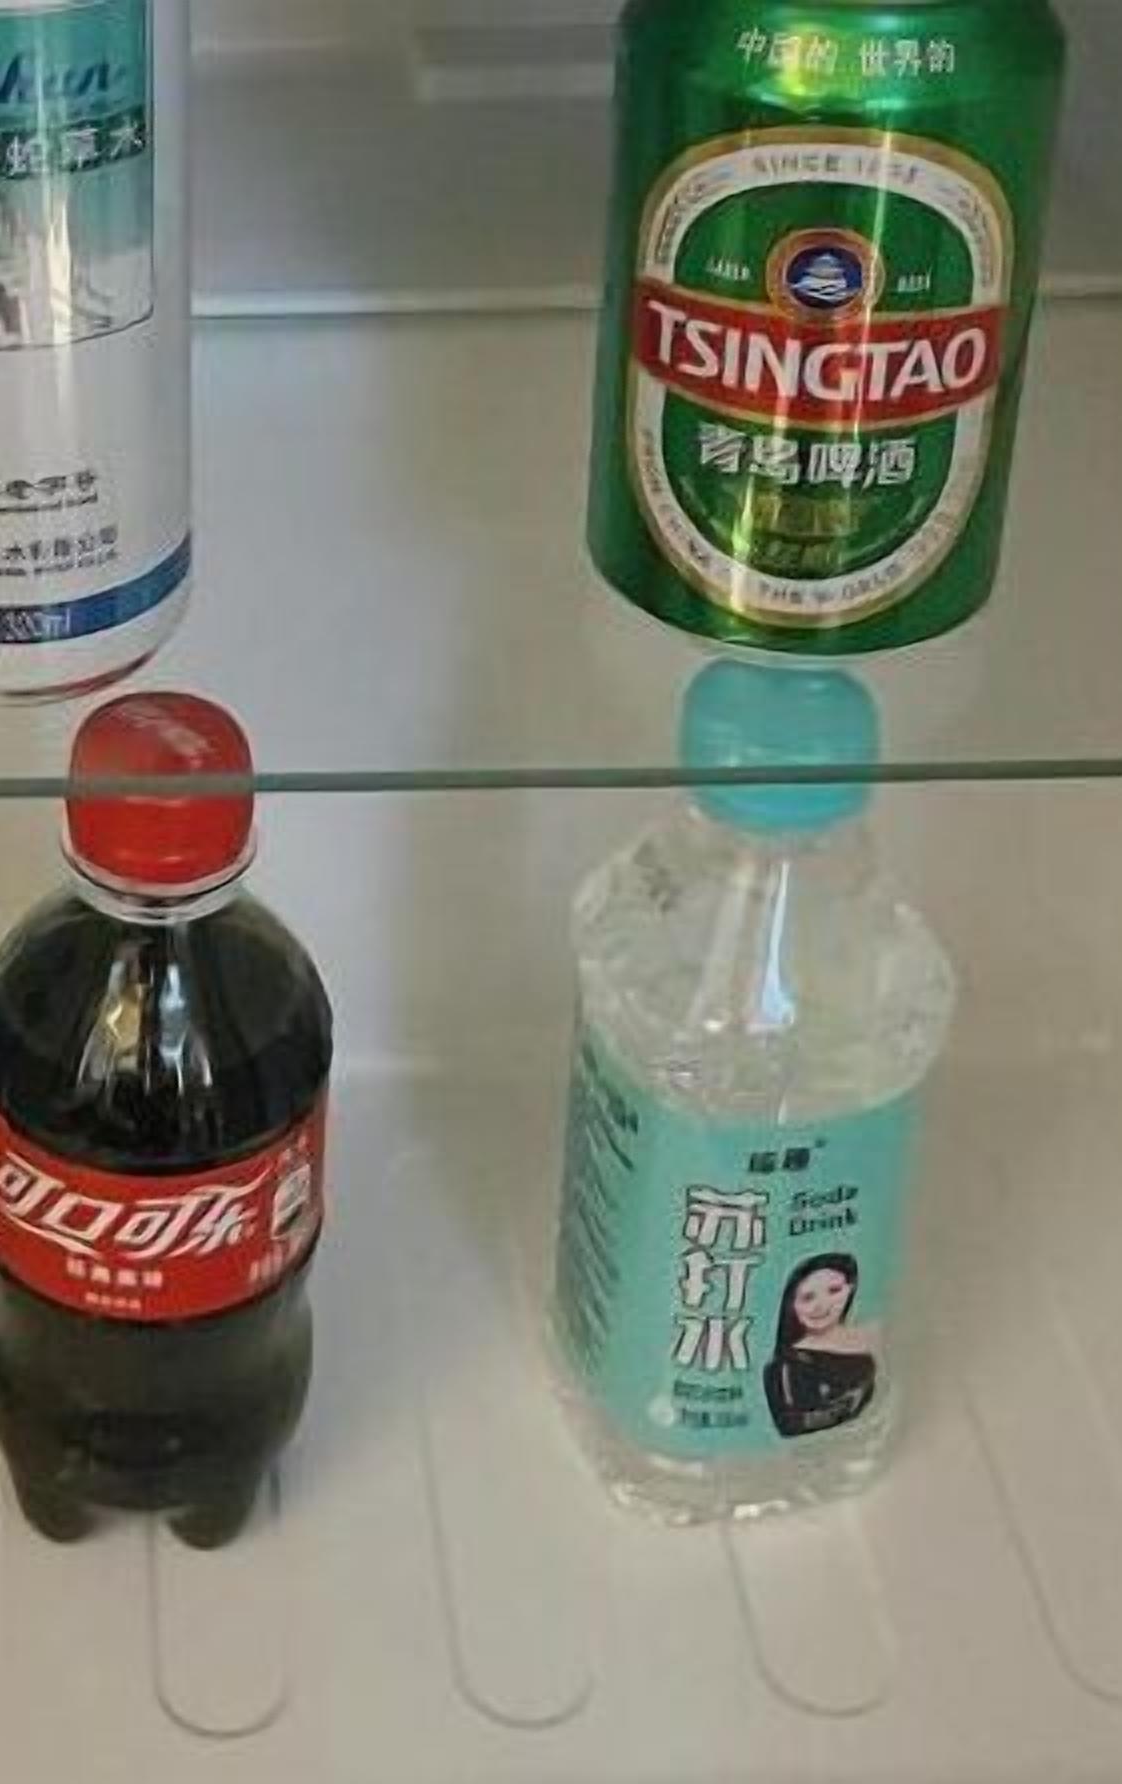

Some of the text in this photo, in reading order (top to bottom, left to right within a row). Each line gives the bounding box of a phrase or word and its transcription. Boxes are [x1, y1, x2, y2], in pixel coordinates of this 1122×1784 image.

[734, 26, 956, 77] 中国的 世界的
[648, 298, 987, 402] TSINGTAO
[698, 423, 917, 489] 青岛啤酒
[789, 1206, 858, 1238] Drink
[674, 1183, 770, 1374] 苏打水
